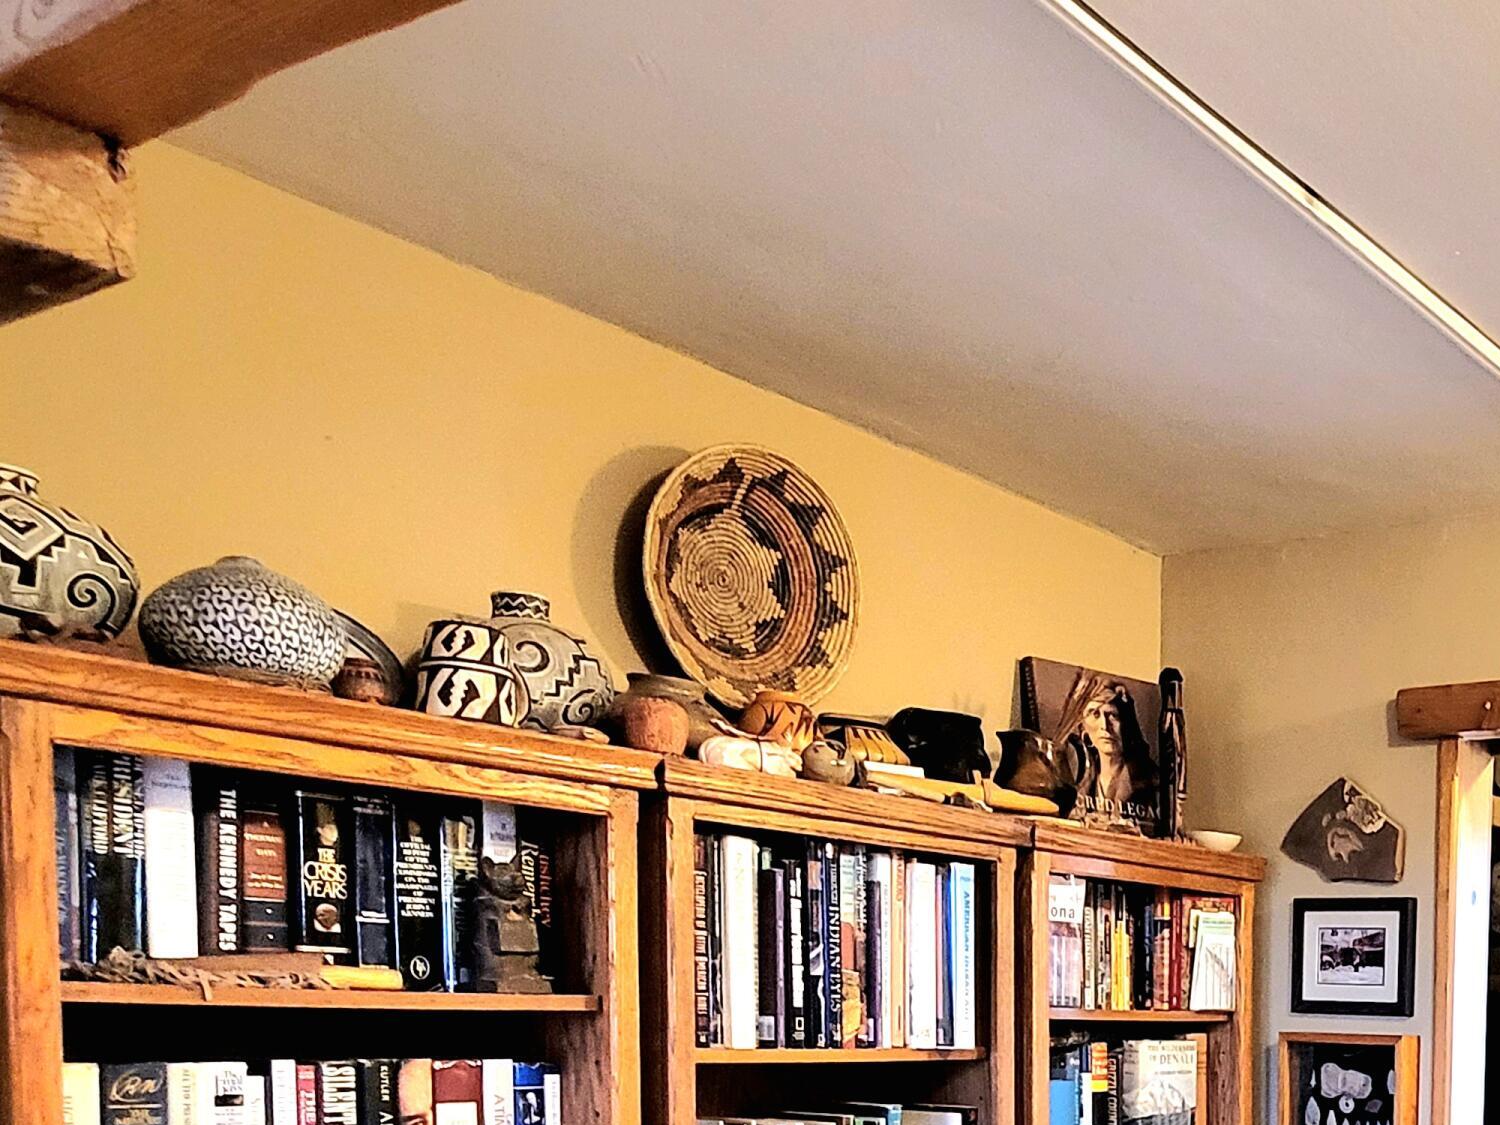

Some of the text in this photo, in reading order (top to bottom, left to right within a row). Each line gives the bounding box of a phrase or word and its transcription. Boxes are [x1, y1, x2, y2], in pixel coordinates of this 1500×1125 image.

[218, 789, 237, 950] THE KENNEDY TAPES
[304, 861, 347, 883] CRISIS
[318, 848, 336, 863] THE
[304, 879, 348, 900] YEARS
[827, 905, 841, 969] INDIAN
[829, 973, 841, 1012] EYES
[322, 1065, 357, 1125] SILENT
[1108, 1058, 1117, 1095] GRIZZLY
[305, 1090, 316, 1123] THE
